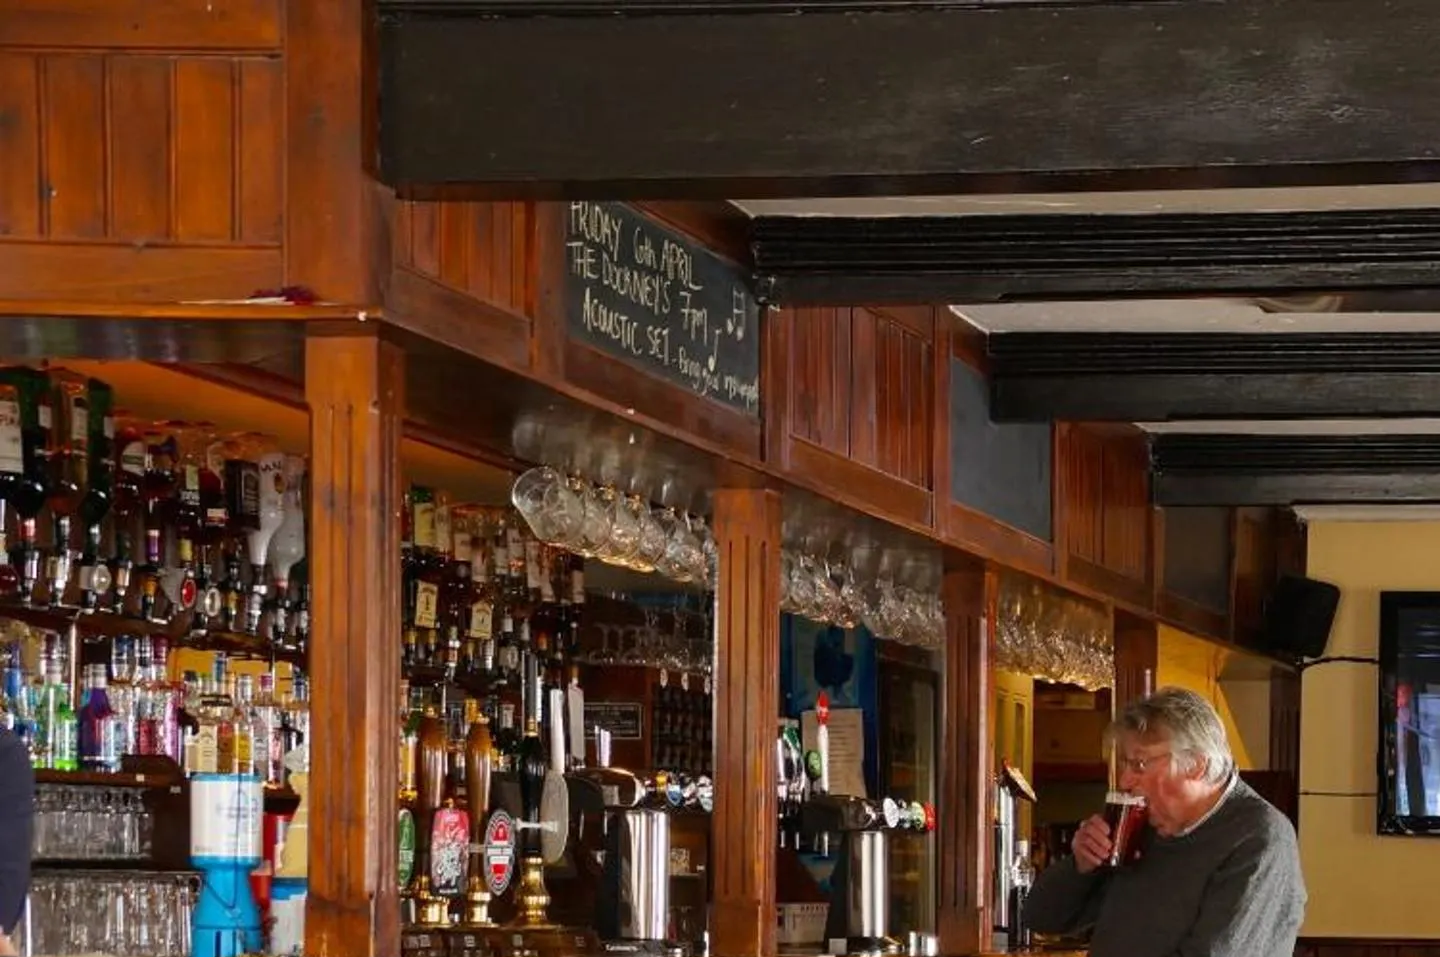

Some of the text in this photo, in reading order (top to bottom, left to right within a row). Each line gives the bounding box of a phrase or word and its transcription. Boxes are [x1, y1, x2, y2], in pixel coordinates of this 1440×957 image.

[564, 241, 600, 279] THE
[569, 200, 623, 262] FRIDAY
[660, 239, 704, 290] APRIL
[582, 286, 642, 354] ACOUSTIC
[646, 323, 670, 367] SET
